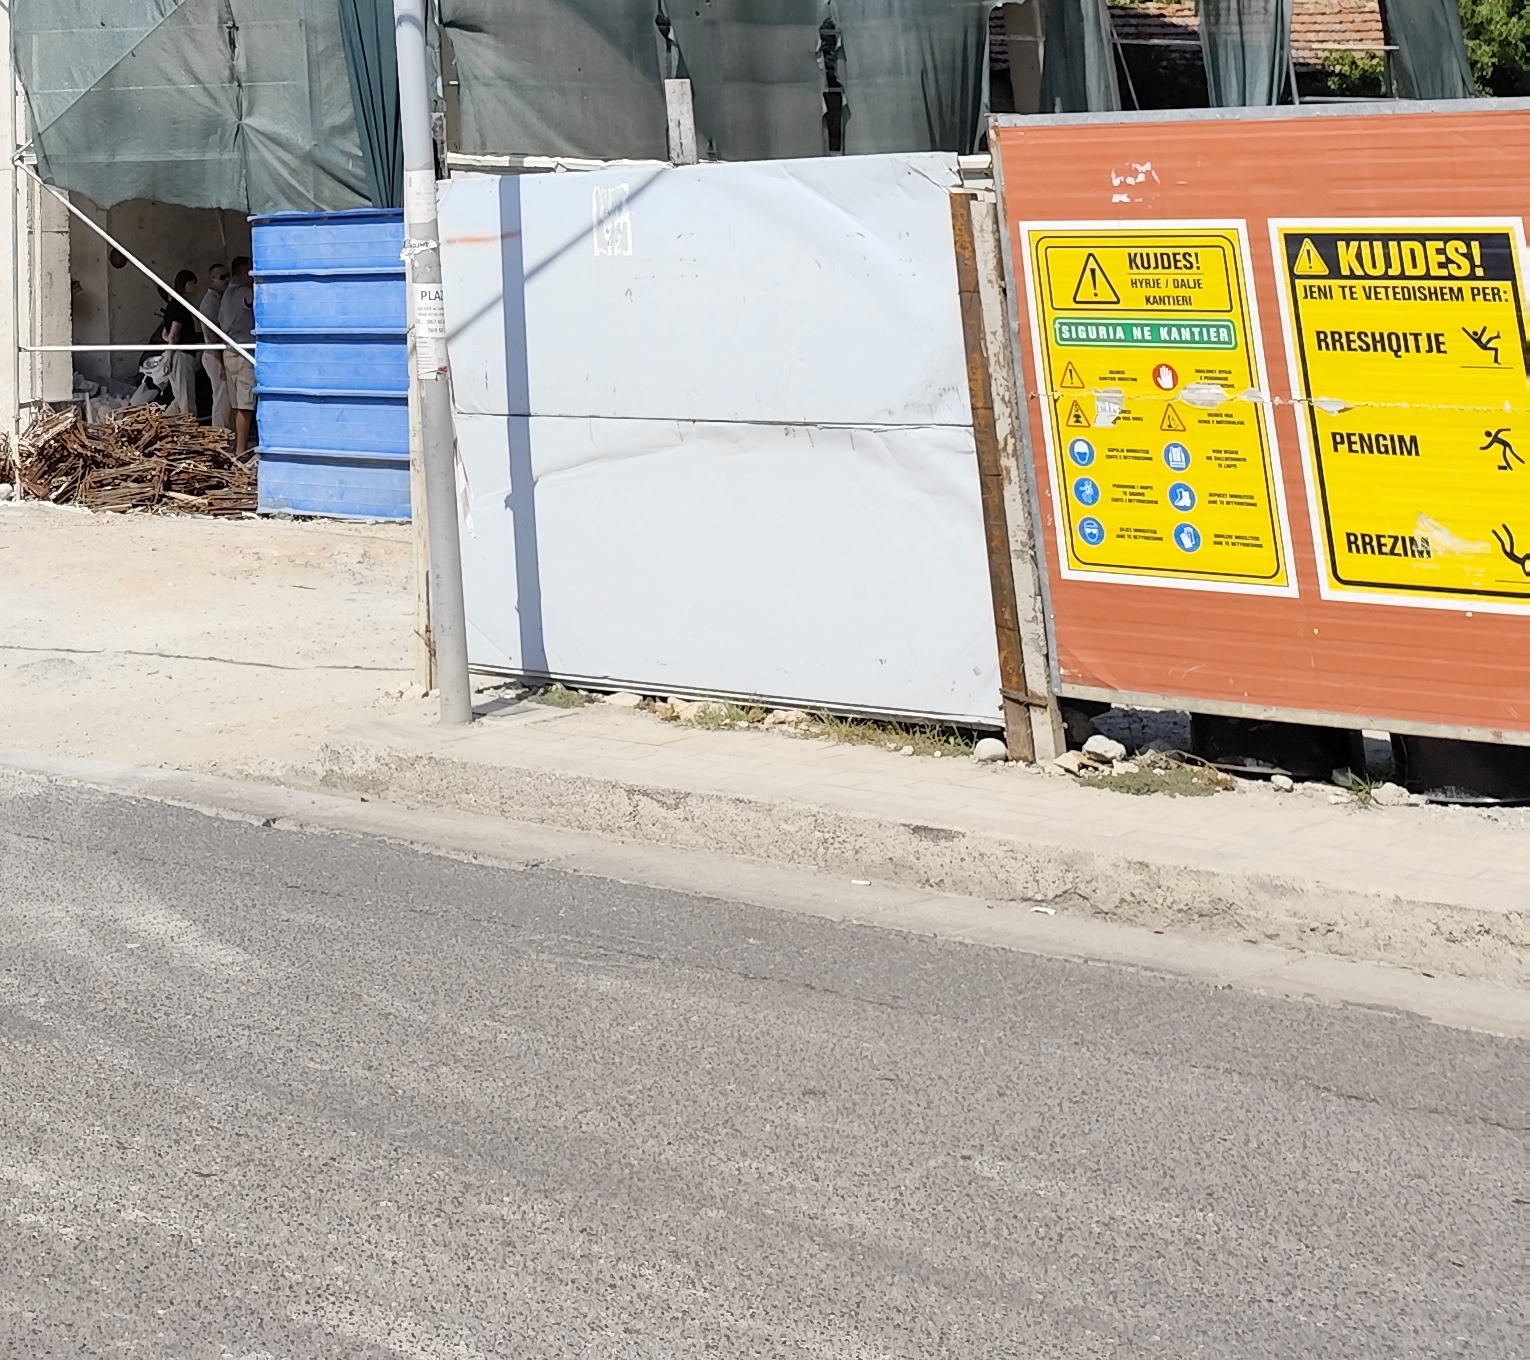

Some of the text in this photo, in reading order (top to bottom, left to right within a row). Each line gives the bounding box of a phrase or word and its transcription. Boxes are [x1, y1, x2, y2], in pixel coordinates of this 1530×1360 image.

[1127, 251, 1201, 271] KUJDES!
[1336, 239, 1485, 278] KUJDES!
[1130, 277, 1162, 289] HYRJE
[1172, 278, 1203, 290] DALJE
[1144, 294, 1193, 307] KANTIERI
[1302, 284, 1509, 304] JENI TE VETEDISHEM PER:
[1061, 324, 1229, 342] SIGURIA NE KANTIER
[1315, 329, 1448, 359] RRESHQITJE
[1330, 431, 1421, 457] PENGIM
